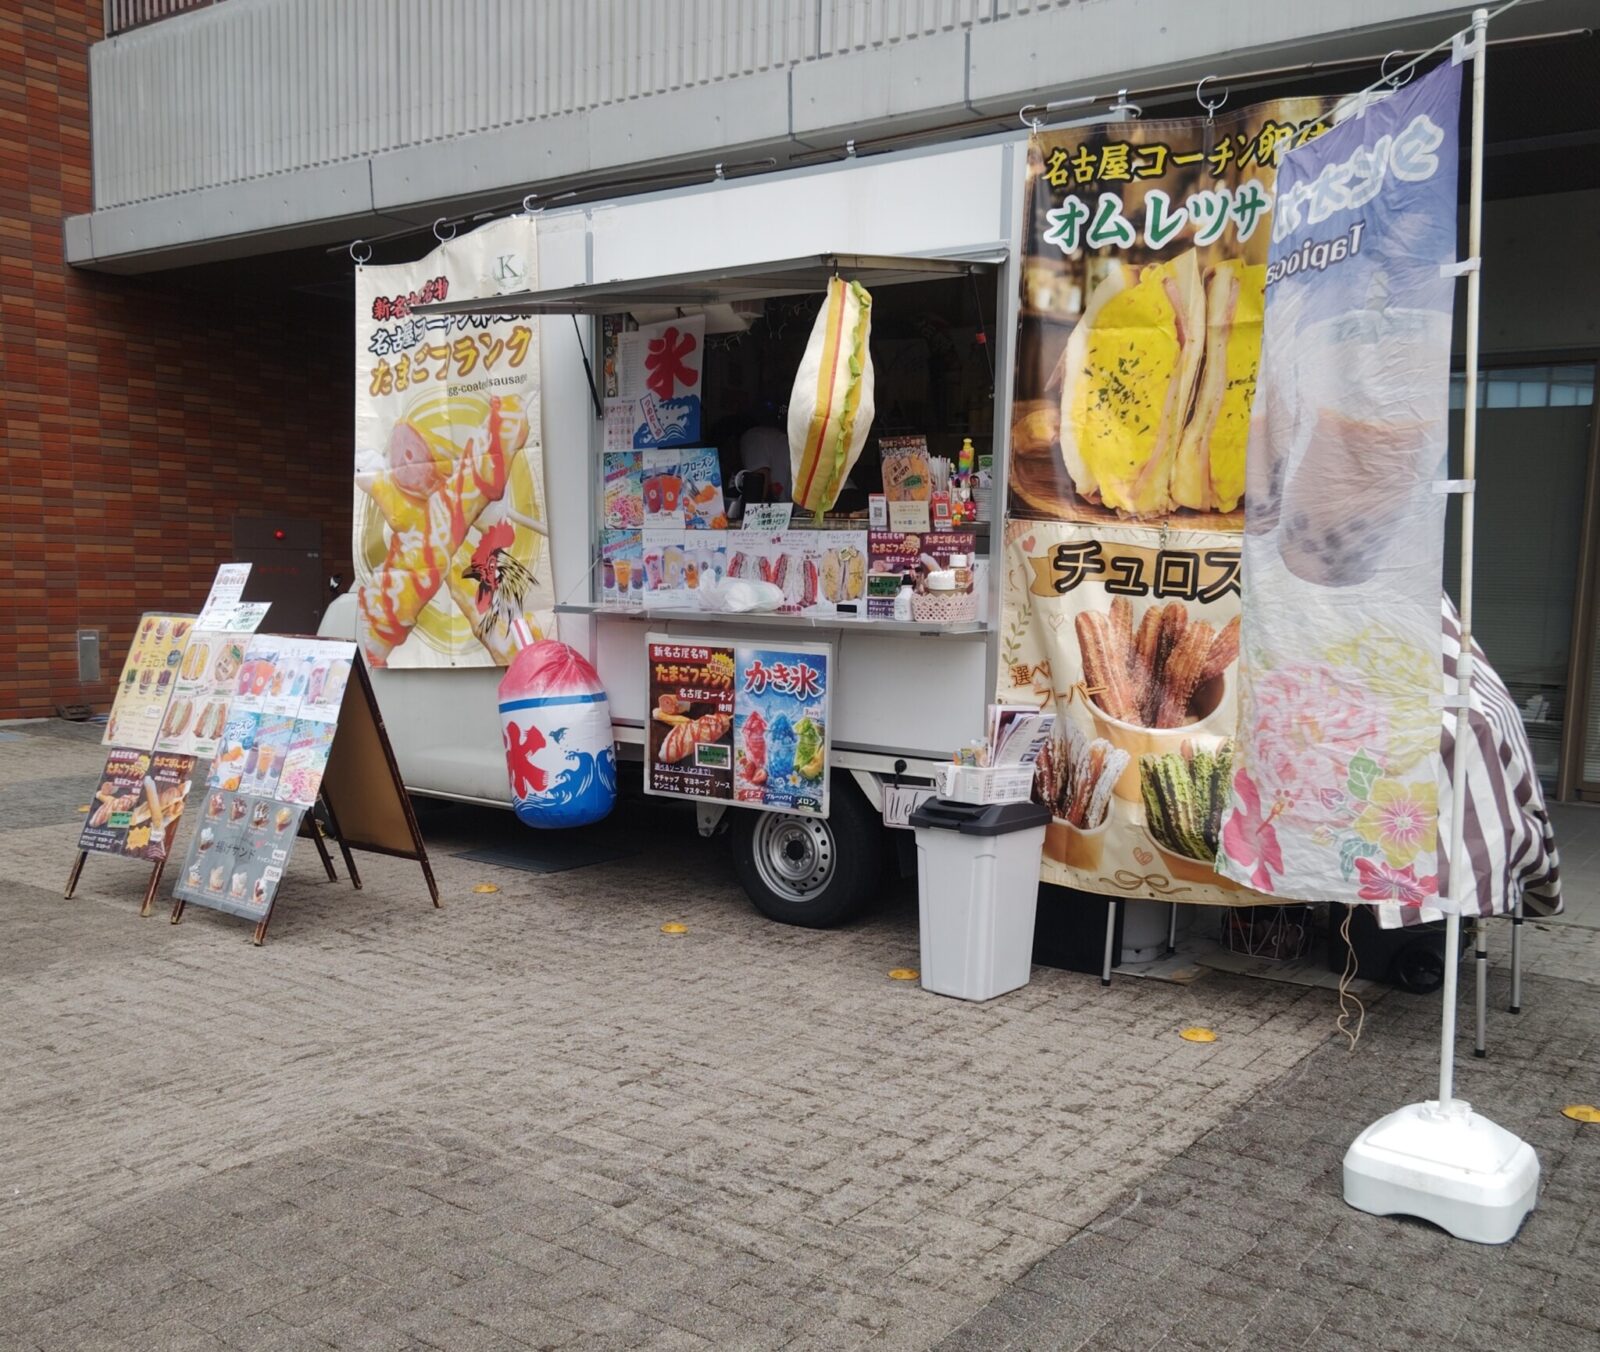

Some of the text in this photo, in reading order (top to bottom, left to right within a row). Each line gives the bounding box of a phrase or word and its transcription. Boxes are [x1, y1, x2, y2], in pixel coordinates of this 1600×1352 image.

[1042, 119, 1334, 187] 名古屋コーチン卵
[1043, 179, 1272, 255] オムレツサ
[497, 254, 519, 279] K
[369, 325, 532, 396] たまごフランク
[645, 326, 698, 402] 氷
[682, 456, 715, 475] フローズン
[692, 469, 713, 481] ゼリー
[1053, 540, 1241, 605] チュロス
[654, 646, 709, 659] 新名古屋名物
[655, 664, 732, 688] たまごフランク
[744, 660, 824, 701] かき氷
[680, 688, 734, 701] 名古屋コーチン
[715, 781, 730, 789] ソース
[796, 797, 816, 806] メロン
